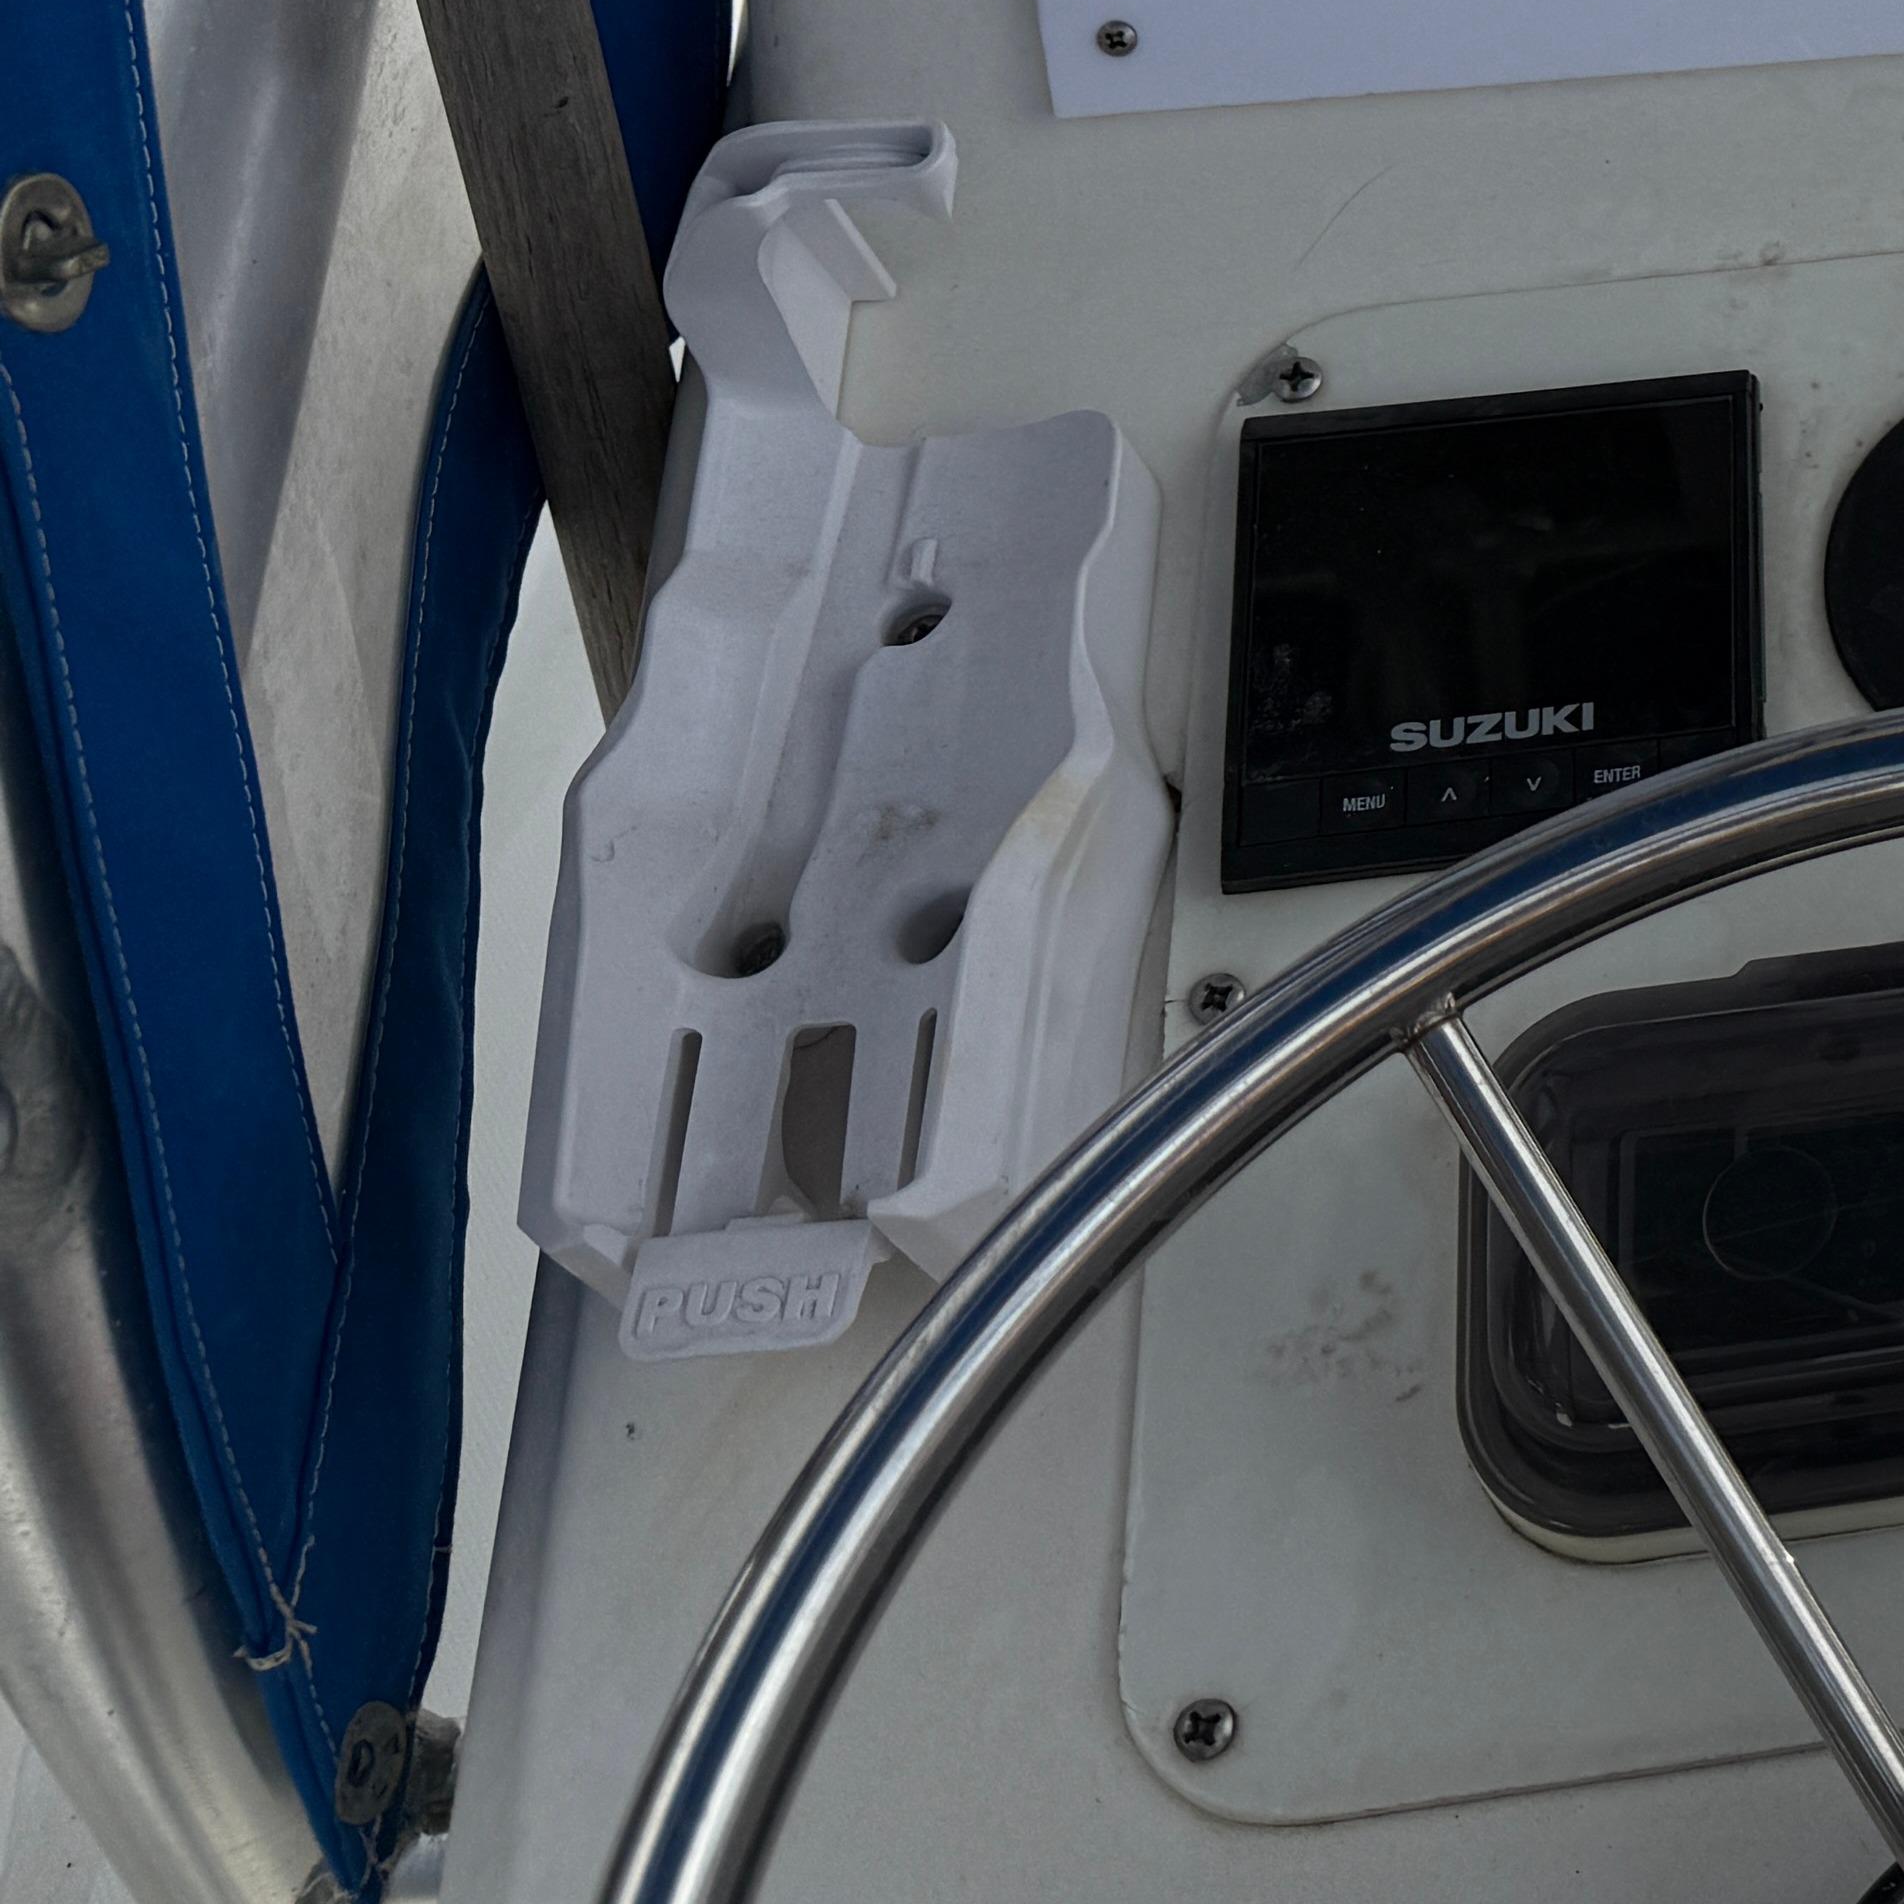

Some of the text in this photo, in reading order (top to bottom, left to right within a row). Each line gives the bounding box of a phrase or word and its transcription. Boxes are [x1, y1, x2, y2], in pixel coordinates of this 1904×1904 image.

[1390, 701, 1594, 752] SUZUKI
[1593, 763, 1641, 784] ENTER
[1342, 793, 1386, 812] MENU
[636, 1272, 841, 1337] PUSH
